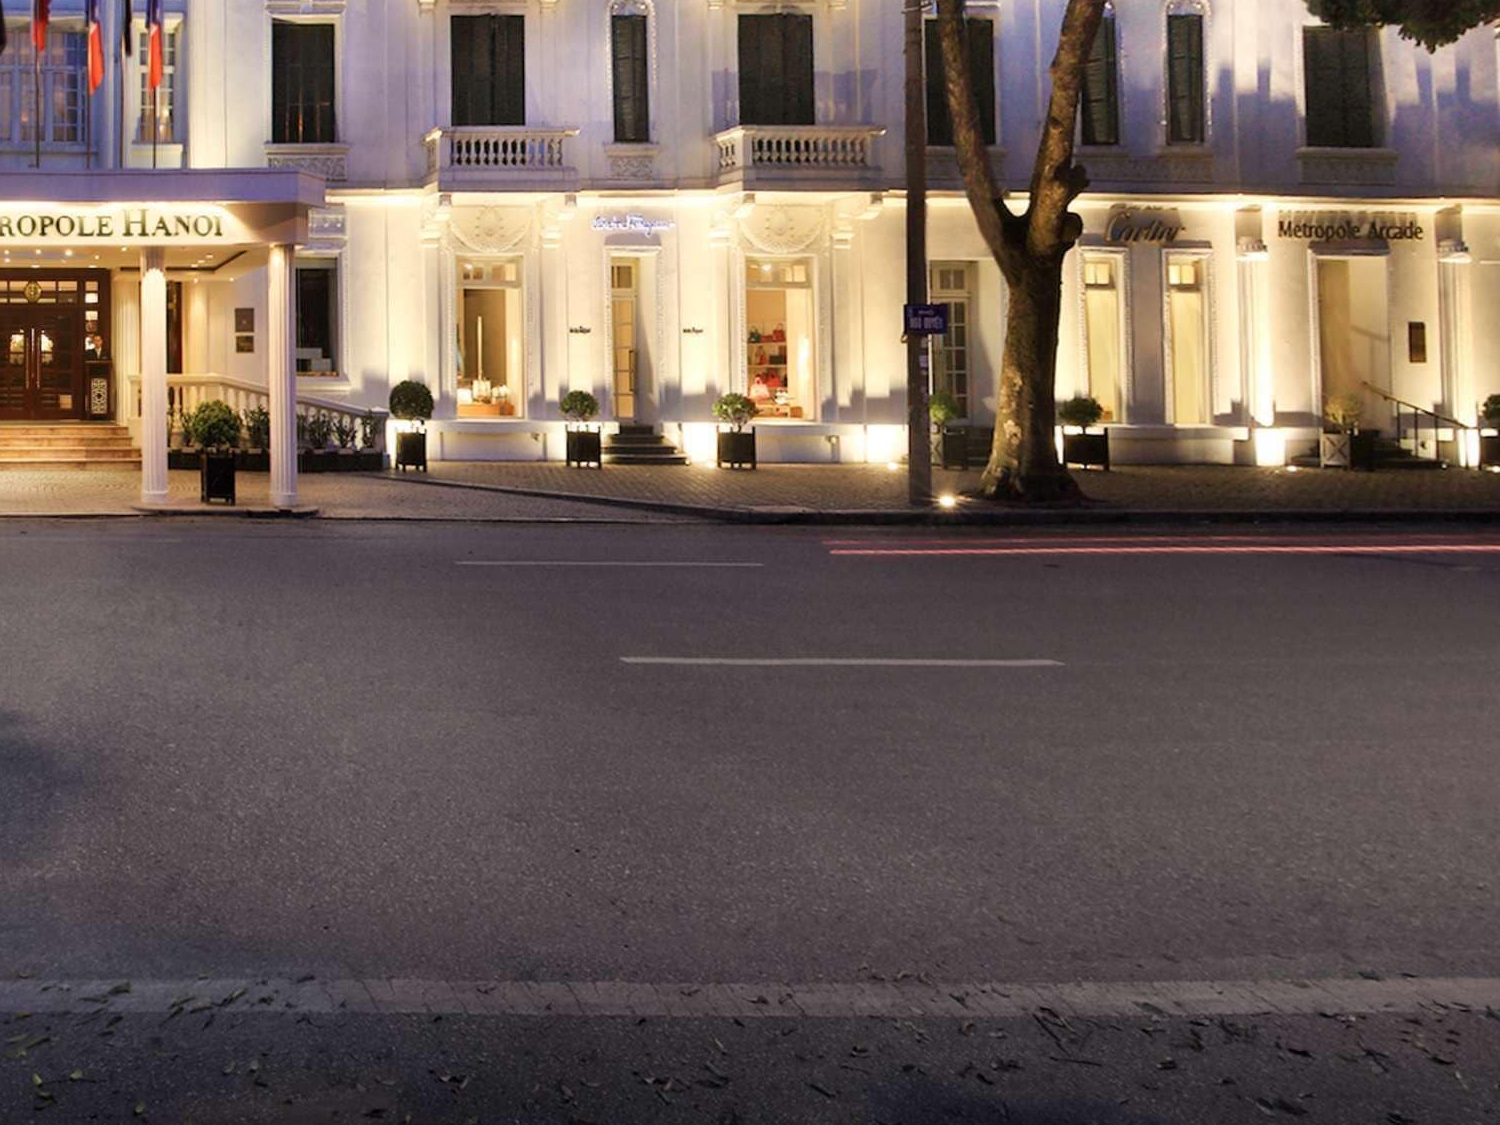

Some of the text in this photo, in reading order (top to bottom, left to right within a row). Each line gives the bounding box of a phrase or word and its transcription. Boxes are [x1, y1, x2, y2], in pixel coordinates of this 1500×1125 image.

[121, 208, 224, 237] HANOI
[1277, 220, 1425, 242] Metropole Arcade
